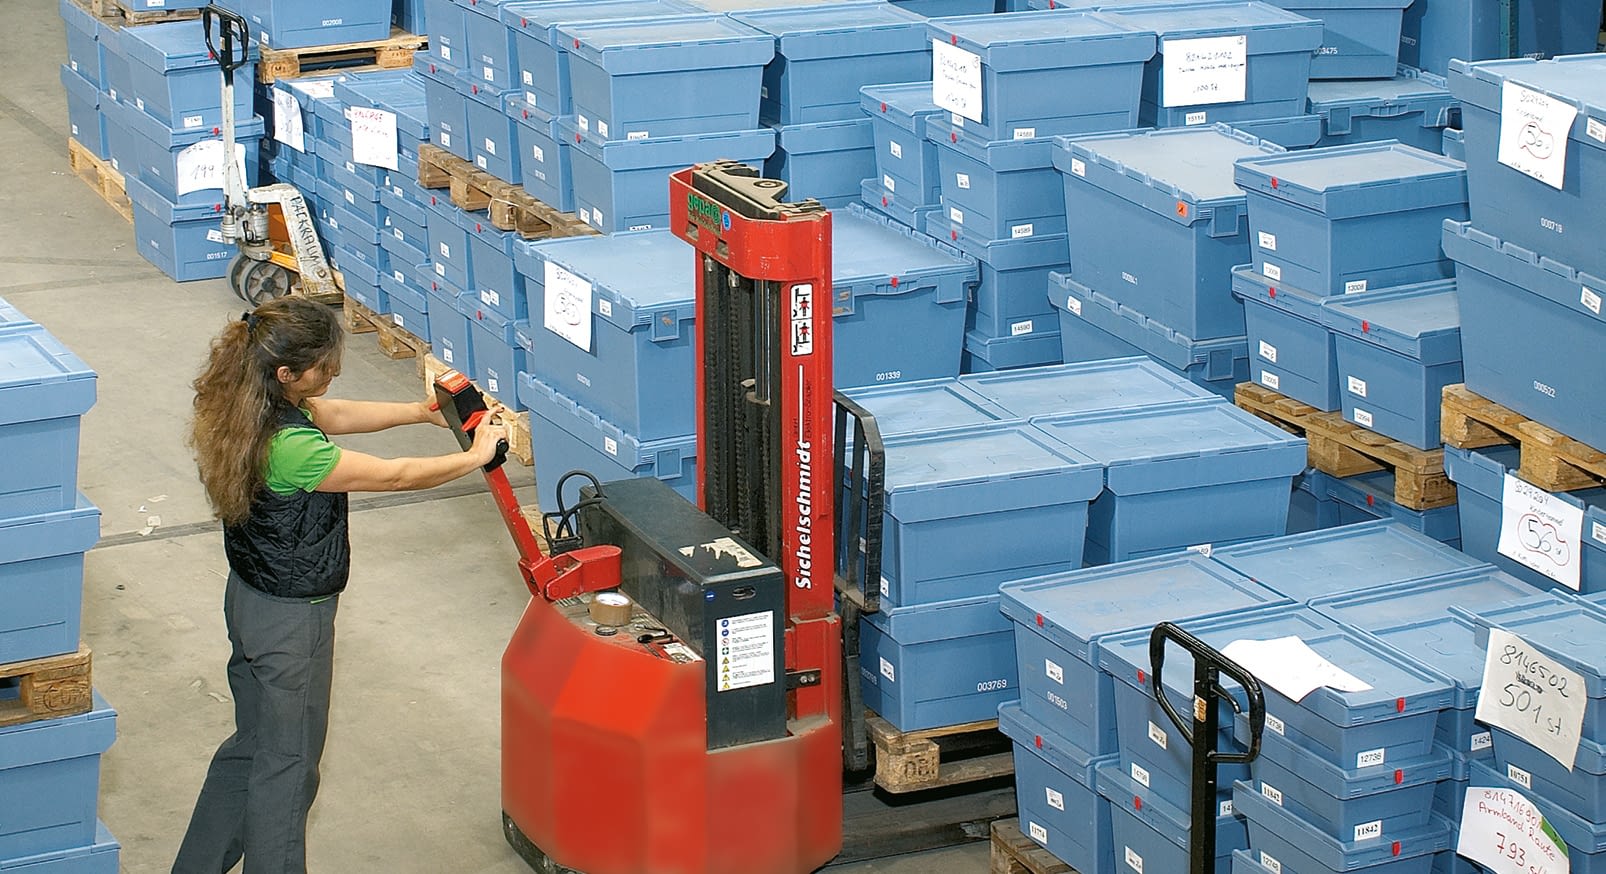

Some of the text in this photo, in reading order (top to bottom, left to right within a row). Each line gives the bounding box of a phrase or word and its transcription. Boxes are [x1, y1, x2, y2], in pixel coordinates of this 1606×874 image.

[290, 195, 321, 267] PACKRAUM
[795, 440, 811, 590] Sichelschmidt
[976, 679, 1008, 692] 003769
[1500, 644, 1569, 698] 8146502
[1499, 683, 1542, 724] 501
[1263, 786, 1280, 802] 11842
[1357, 824, 1378, 836] 11842
[1479, 801, 1524, 832] Armband
[1496, 832, 1525, 867] 793
